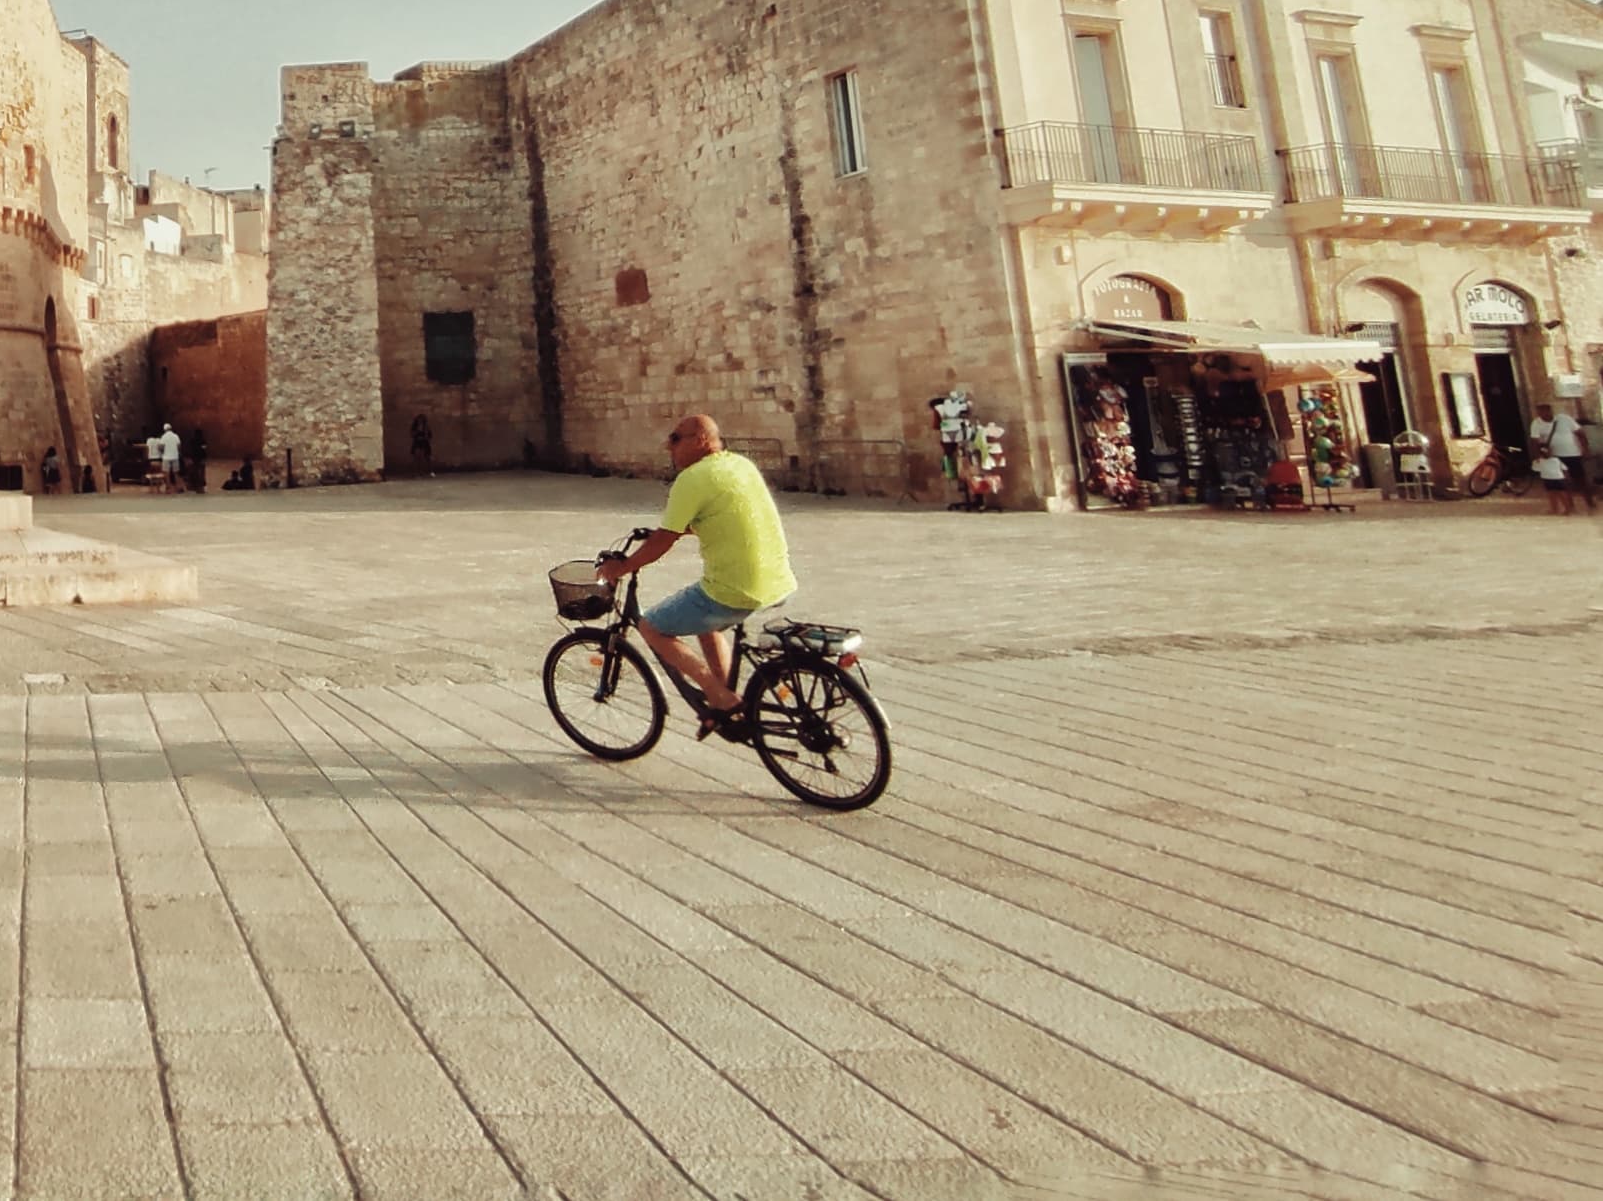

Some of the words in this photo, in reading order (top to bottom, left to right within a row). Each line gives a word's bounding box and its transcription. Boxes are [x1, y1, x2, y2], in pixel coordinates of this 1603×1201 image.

[1465, 287, 1485, 309] AR
[1487, 286, 1526, 314] MOLO
[1113, 309, 1143, 319] BAZAR
